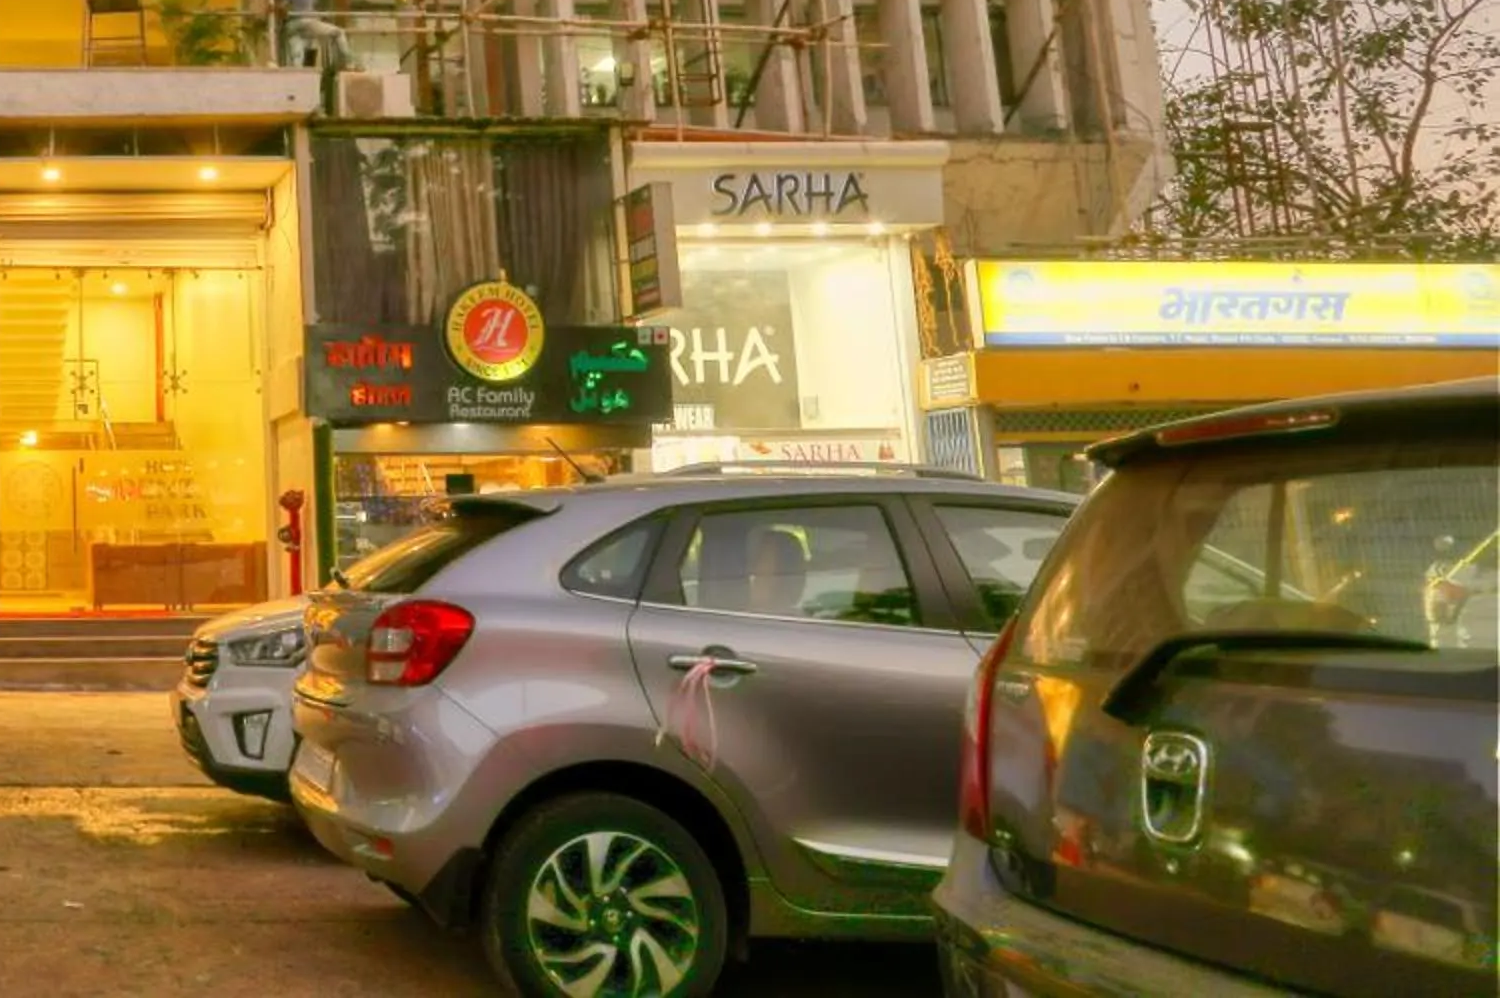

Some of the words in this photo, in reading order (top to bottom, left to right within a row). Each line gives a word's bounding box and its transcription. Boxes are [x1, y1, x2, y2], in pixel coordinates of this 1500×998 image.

[712, 172, 869, 216] SARHA
[447, 387, 474, 404] AC
[477, 386, 535, 412] Family
[450, 403, 532, 418] Restaurant
[781, 442, 861, 462] SARHA
